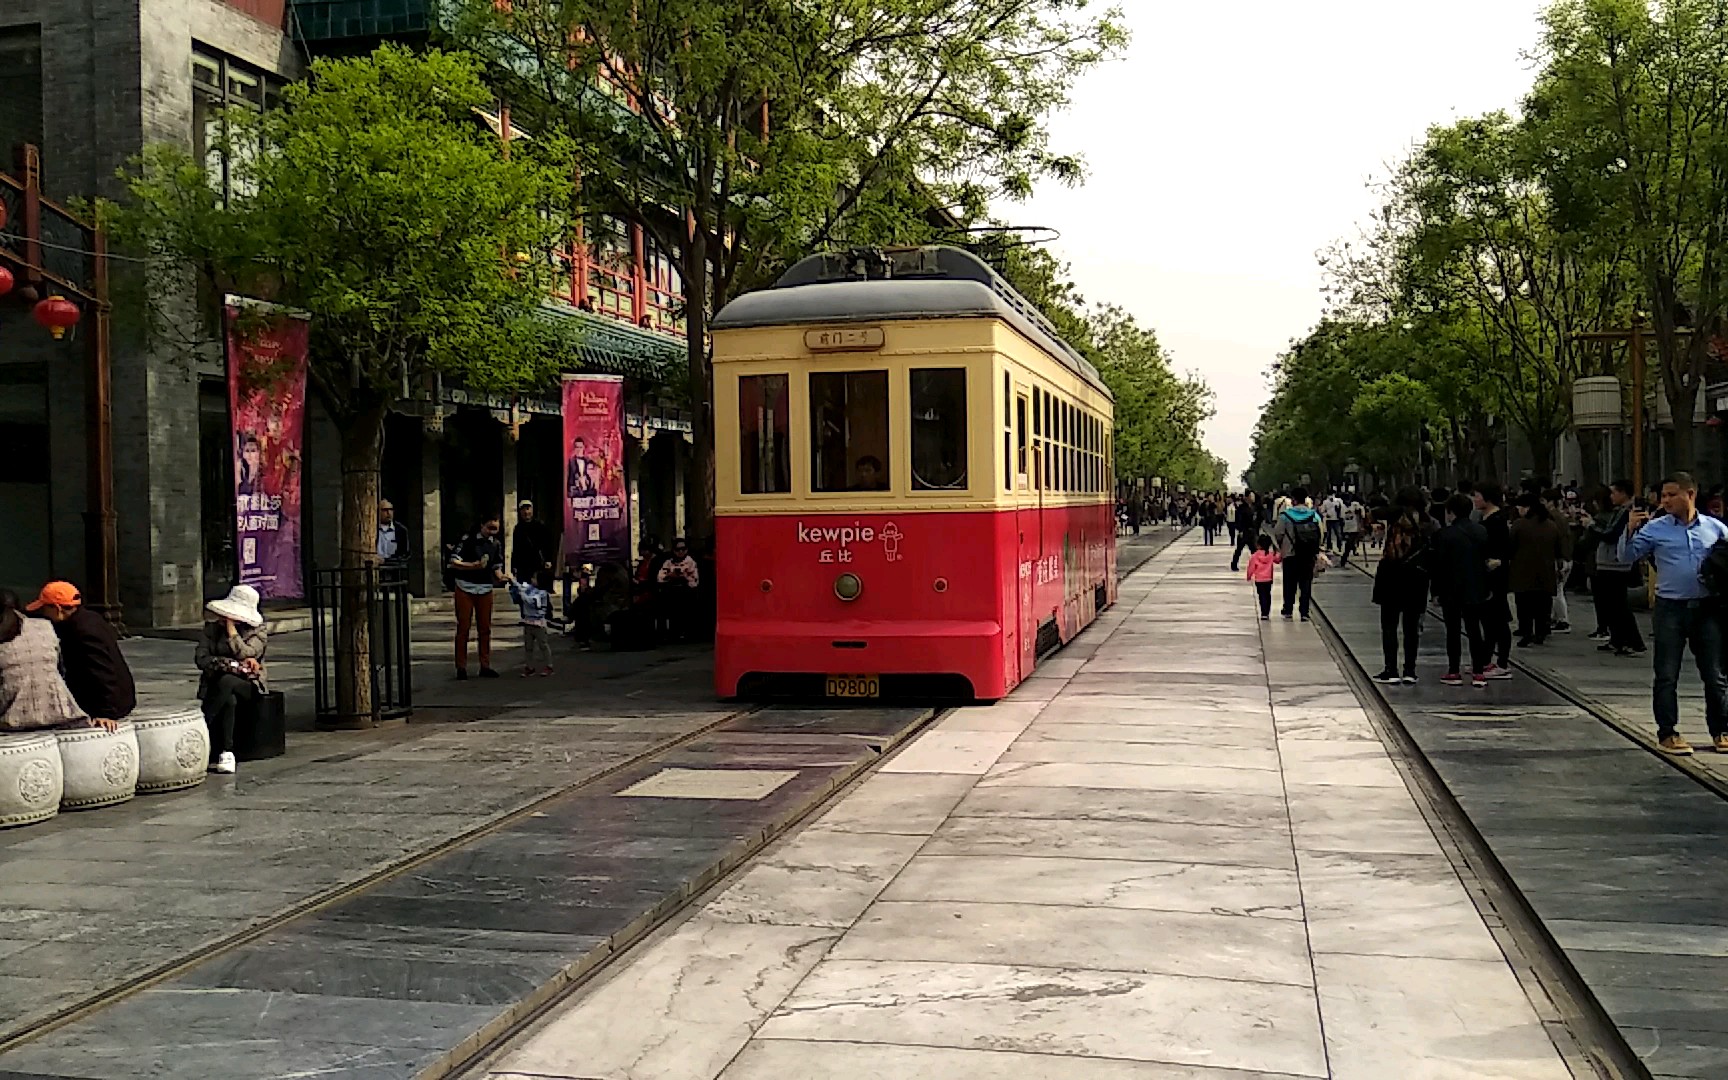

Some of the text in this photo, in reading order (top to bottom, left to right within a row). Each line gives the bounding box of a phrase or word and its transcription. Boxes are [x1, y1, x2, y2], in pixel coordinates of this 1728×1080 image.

[797, 520, 875, 548] kewpie
[818, 549, 853, 563] 丘比
[827, 679, 878, 696] D9800
